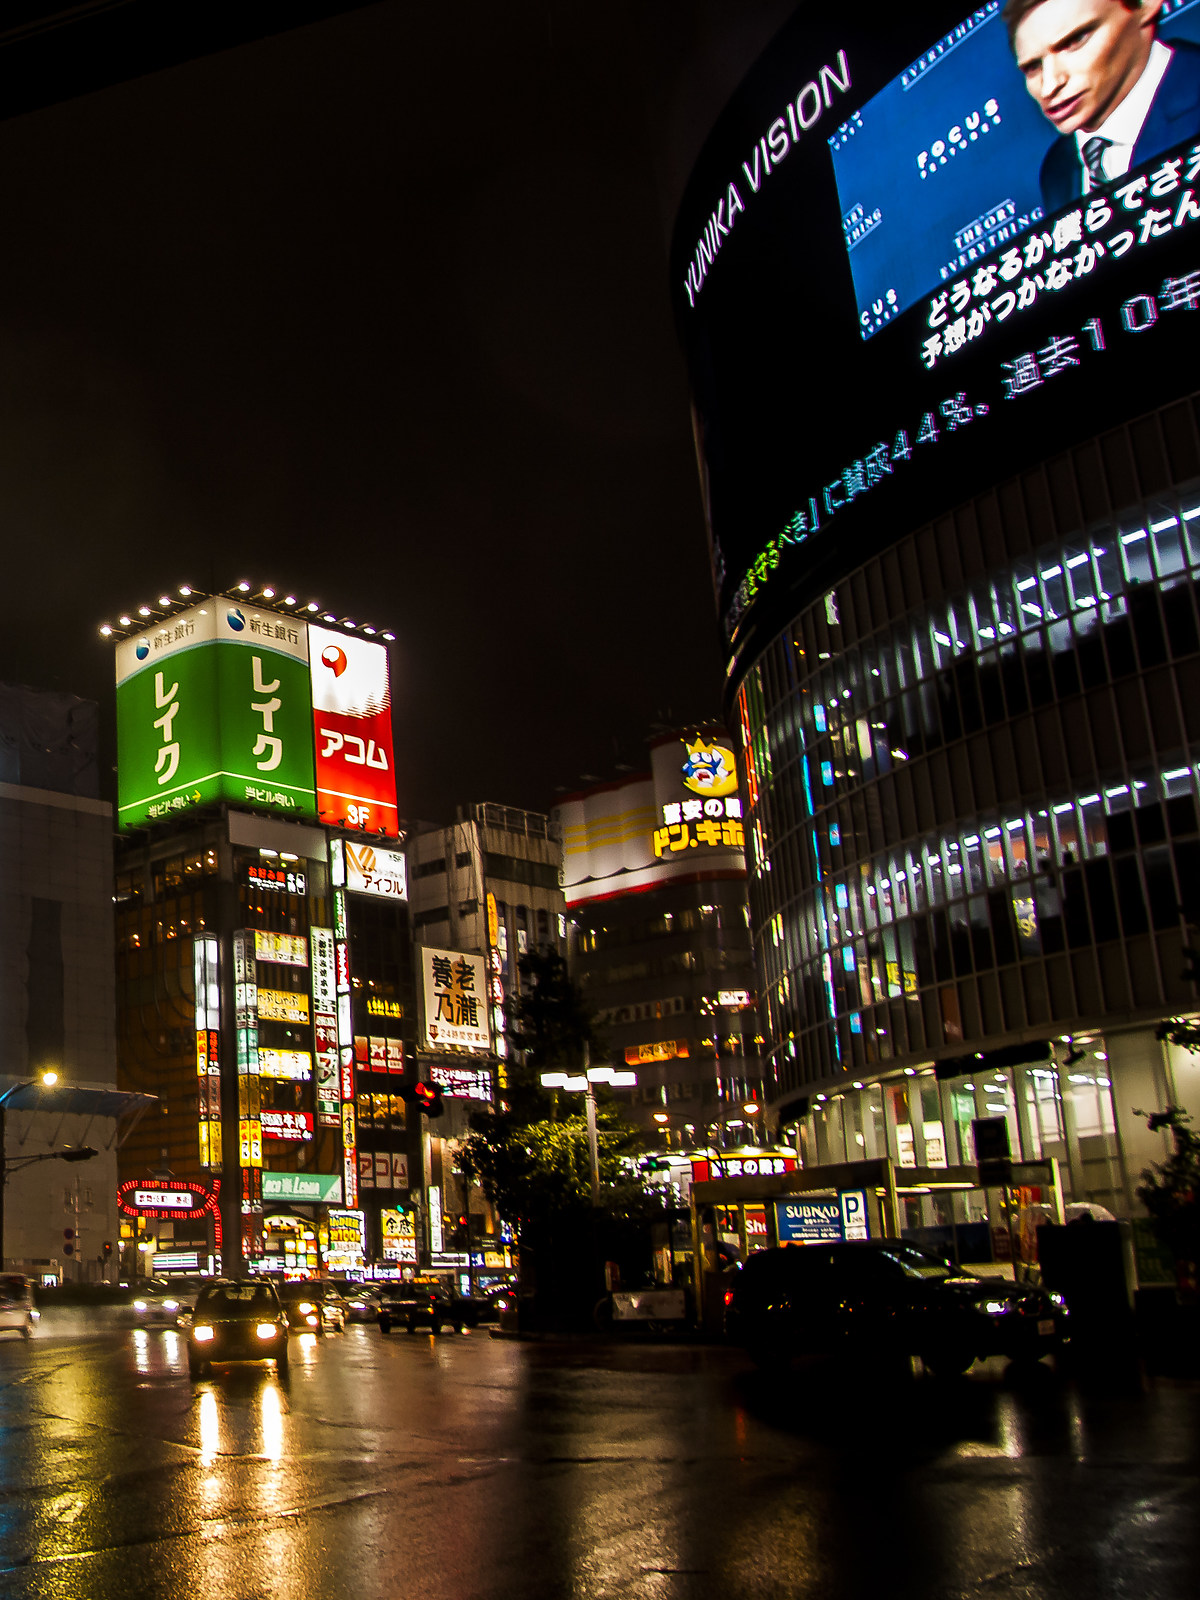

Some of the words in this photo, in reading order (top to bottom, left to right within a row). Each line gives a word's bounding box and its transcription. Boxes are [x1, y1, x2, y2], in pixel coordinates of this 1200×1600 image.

[917, 98, 999, 169] FOCUS
[684, 182, 745, 308] YUNIKA
[742, 49, 852, 193] VISION
[153, 619, 196, 650] 新生銀行
[250, 618, 299, 645] 新生銀行
[153, 671, 180, 786] レイク
[251, 655, 283, 771] レイク
[319, 727, 390, 771] アコム
[244, 785, 296, 808] 当ビル向い
[347, 804, 370, 825] 3F
[362, 873, 404, 895] アイフル
[431, 955, 476, 993] 養老
[434, 991, 480, 1029] 乃瀧
[360, 1157, 406, 1177] アコム
[845, 1196, 860, 1224] P
